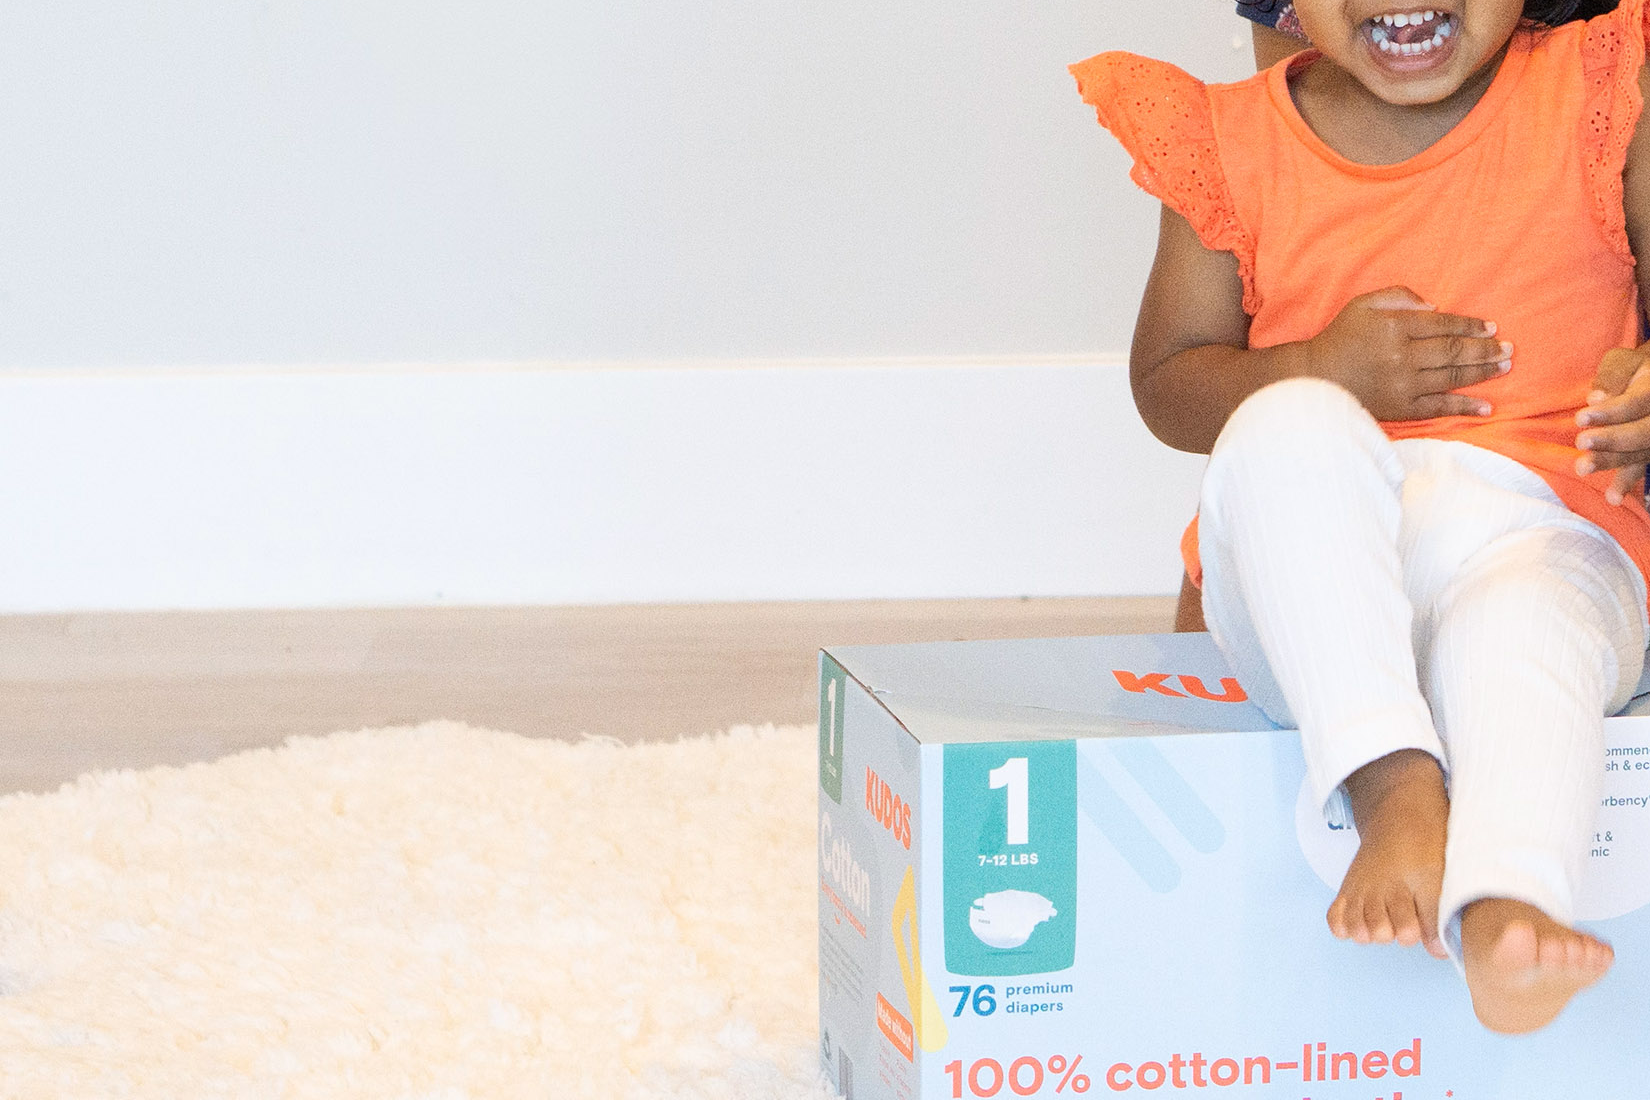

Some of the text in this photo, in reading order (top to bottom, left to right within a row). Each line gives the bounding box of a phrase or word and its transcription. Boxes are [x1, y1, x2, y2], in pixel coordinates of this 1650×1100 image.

[827, 677, 837, 758] 1
[1622, 760, 1632, 771] &
[865, 764, 912, 851] KUDOS
[989, 757, 1029, 845] 1
[1604, 831, 1613, 842] &
[821, 811, 871, 918] Cotton
[978, 853, 1039, 867] 7-12 LBS
[949, 984, 997, 1018] 76
[1006, 982, 1074, 999] premium
[1005, 1001, 1064, 1016] diapers
[944, 1053, 1091, 1099] 100%
[1105, 1038, 1422, 1092] cotton-lined
